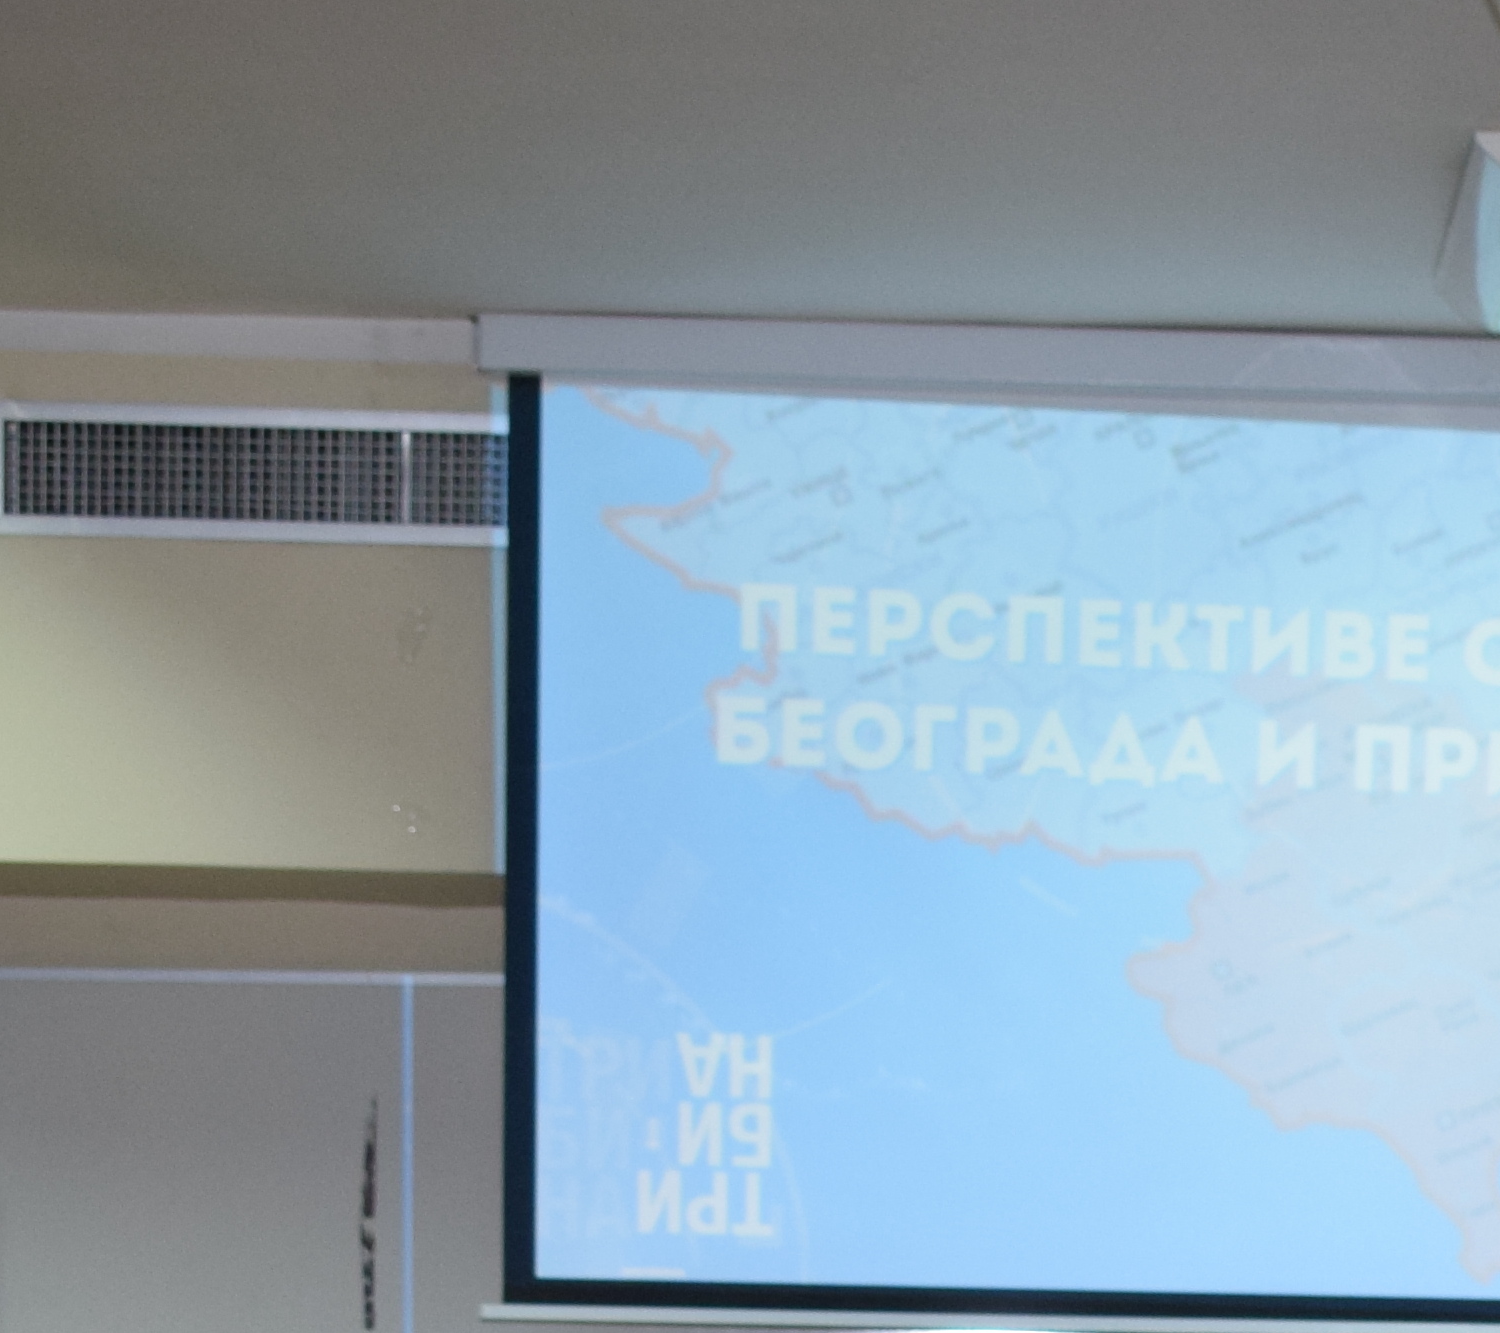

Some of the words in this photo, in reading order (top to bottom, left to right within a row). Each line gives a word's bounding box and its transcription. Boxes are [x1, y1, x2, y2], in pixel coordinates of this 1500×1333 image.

[739, 582, 1430, 682] ПЕРСПЕКТИВЕ
[714, 694, 1226, 786] БЕОГРАДА
[1256, 716, 1316, 788] И
